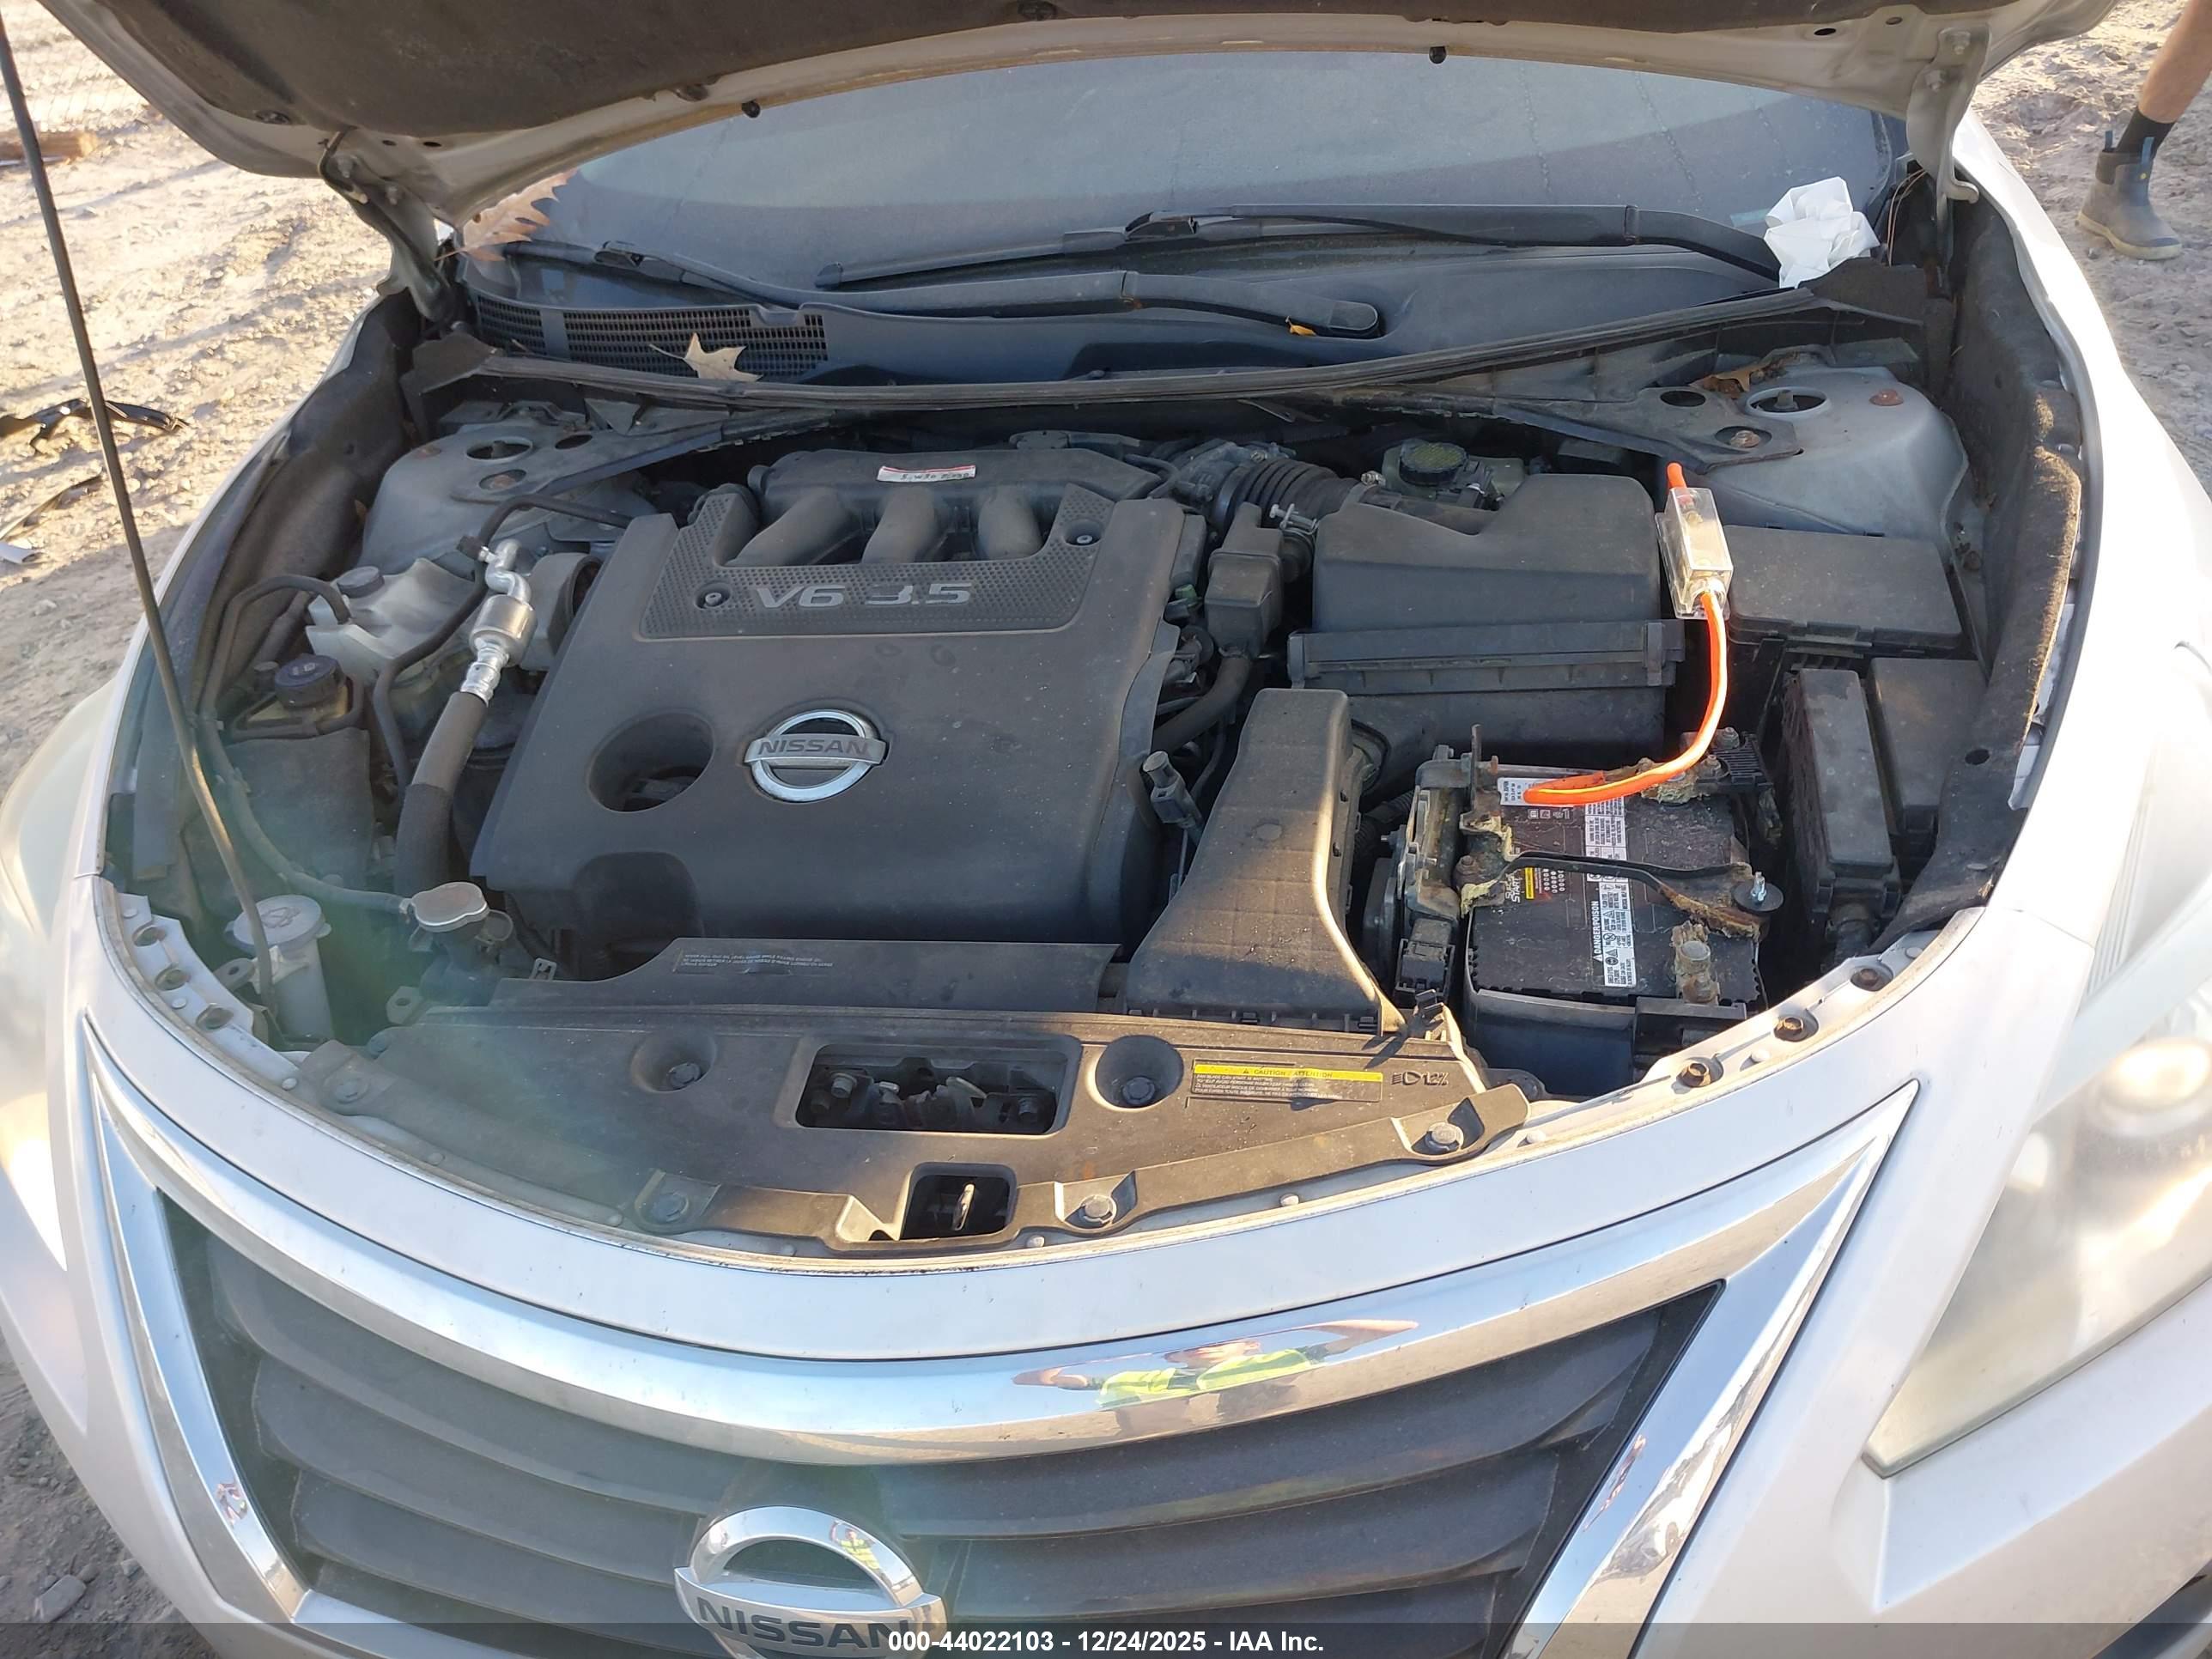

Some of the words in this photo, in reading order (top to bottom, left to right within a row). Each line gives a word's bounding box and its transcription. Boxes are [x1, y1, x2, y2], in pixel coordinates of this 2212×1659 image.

[757, 585, 846, 608] V6
[864, 583, 972, 605] 3.5
[758, 739, 871, 757] NISSAN
[696, 1597, 909, 1648] NISSAN
